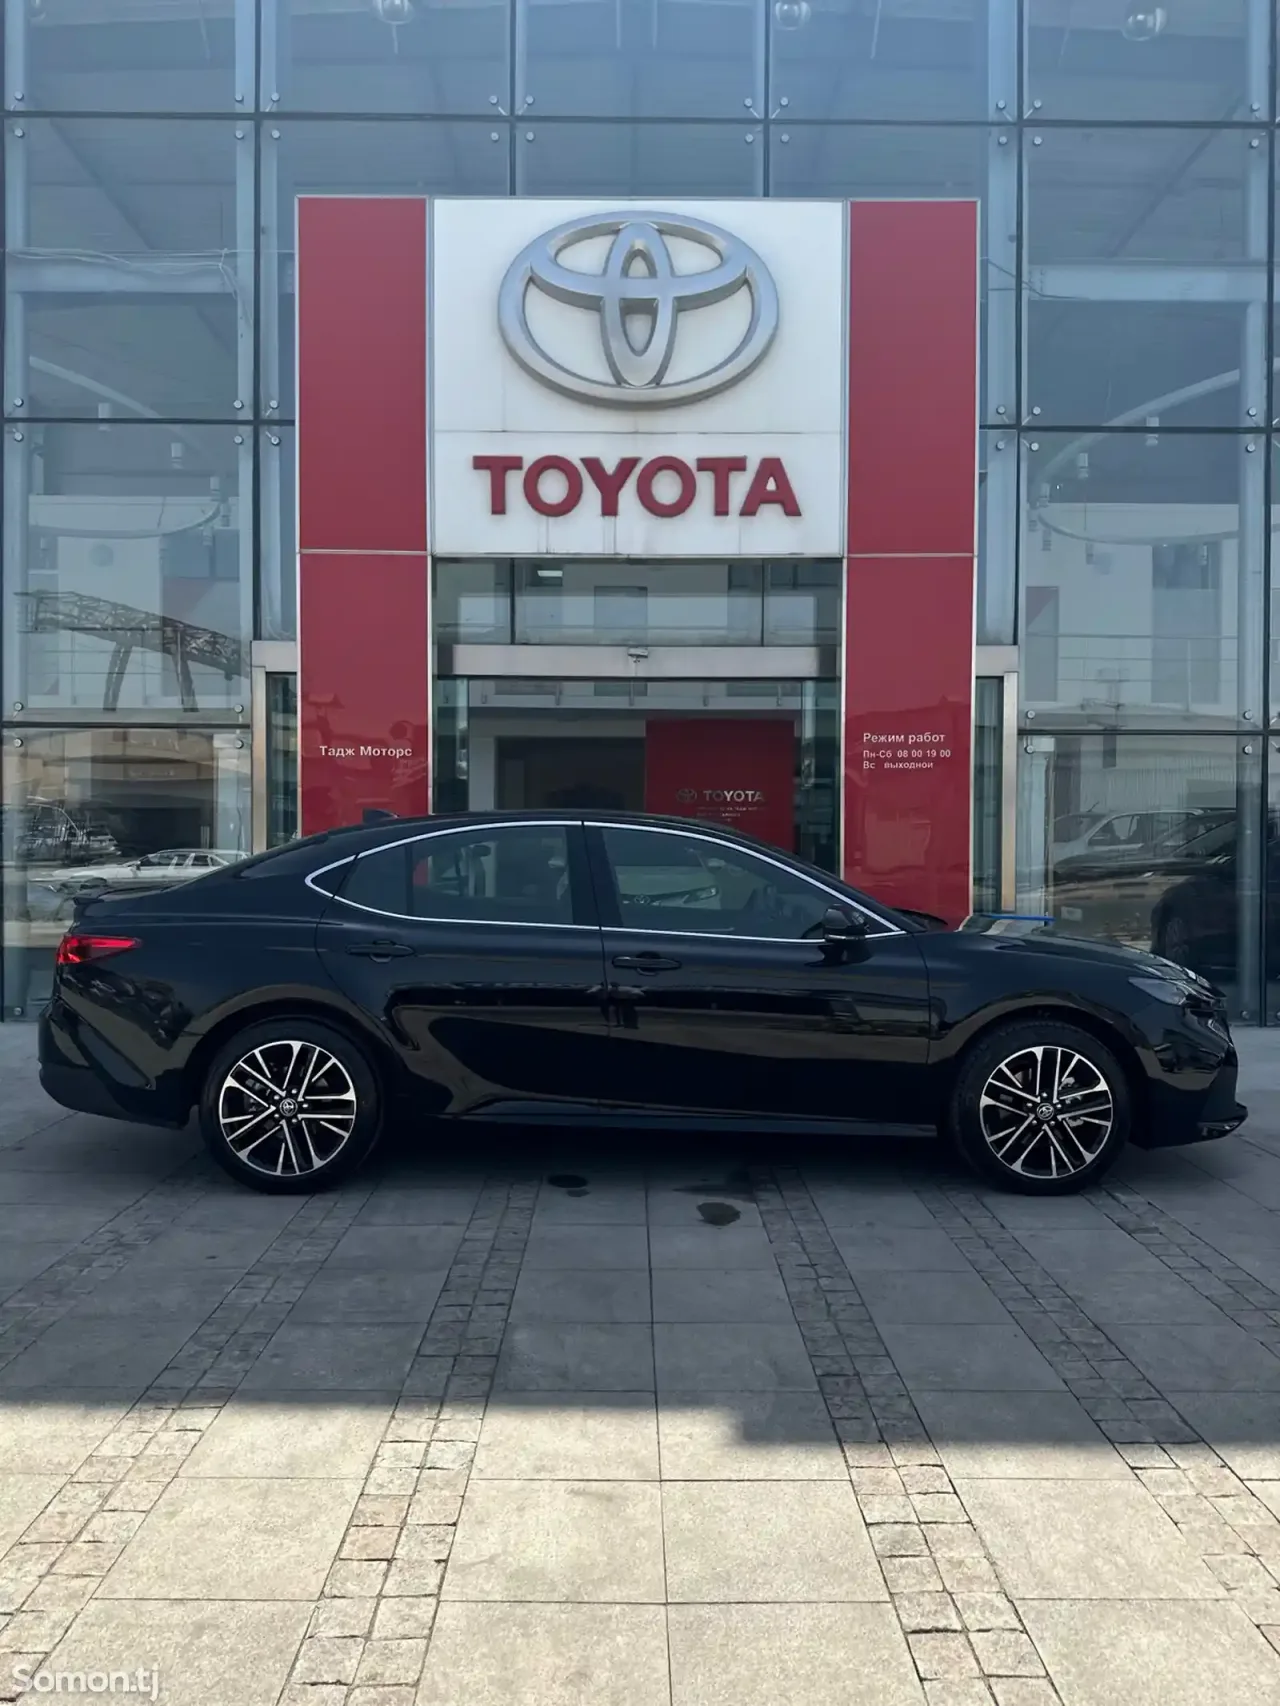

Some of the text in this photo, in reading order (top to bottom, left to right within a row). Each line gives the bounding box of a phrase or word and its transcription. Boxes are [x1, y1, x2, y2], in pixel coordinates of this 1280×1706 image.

[473, 455, 802, 518] TOYOTA
[863, 732, 946, 744] Режим работ
[319, 745, 413, 759] Тадж Моторс
[863, 750, 892, 758] Пн-Сб
[911, 750, 923, 758] 00
[926, 750, 937, 758] 19
[940, 749, 951, 758] 00
[863, 761, 876, 769] Вс
[703, 790, 765, 802] TOYOTA
